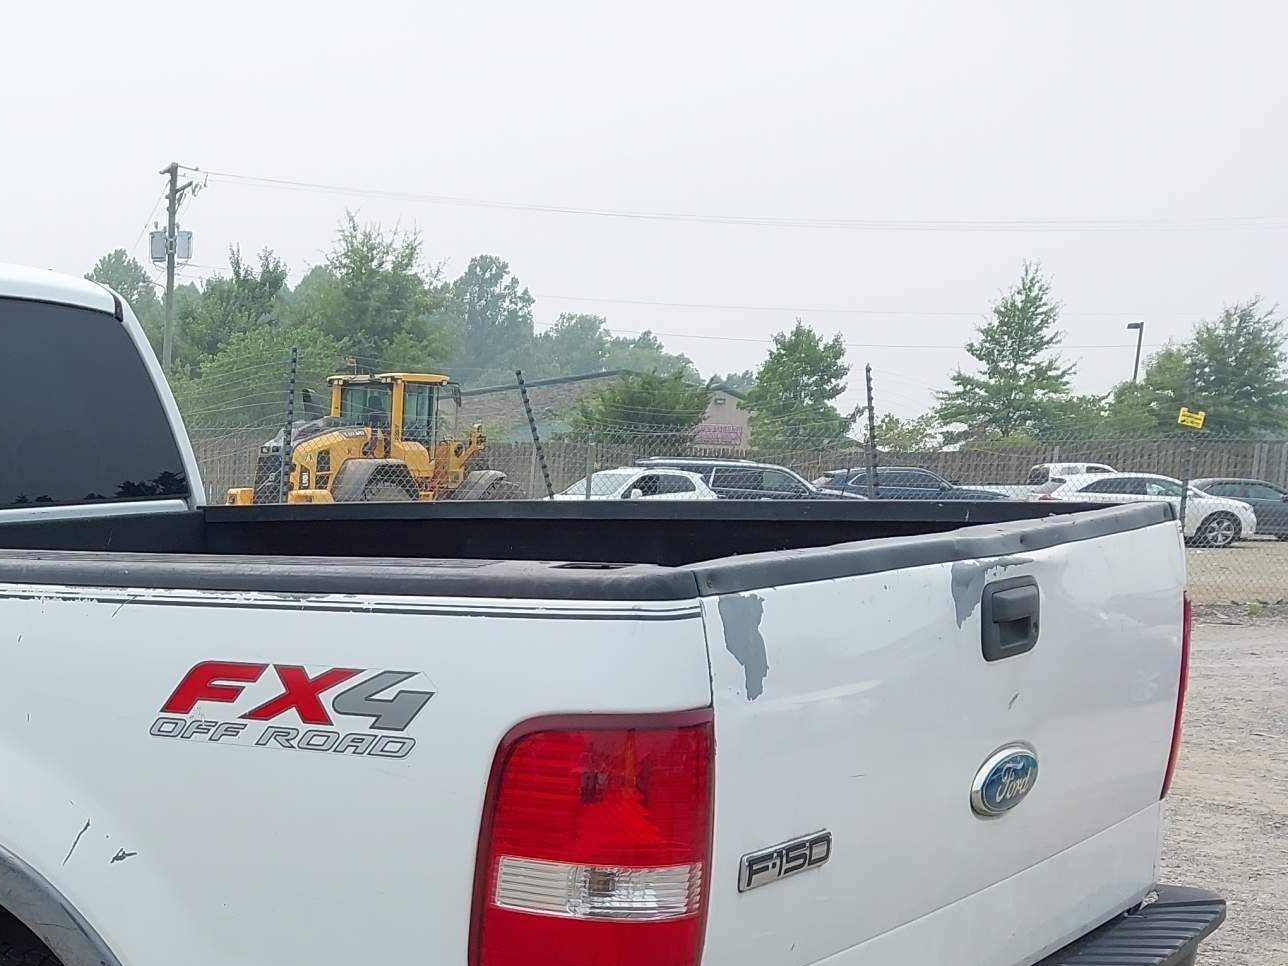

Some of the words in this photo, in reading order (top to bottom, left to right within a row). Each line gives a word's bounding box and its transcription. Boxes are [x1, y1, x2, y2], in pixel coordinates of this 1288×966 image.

[159, 660, 436, 731] FX4
[149, 716, 248, 741] OFF
[255, 725, 417, 759] ROAD
[994, 760, 1034, 803] Ford
